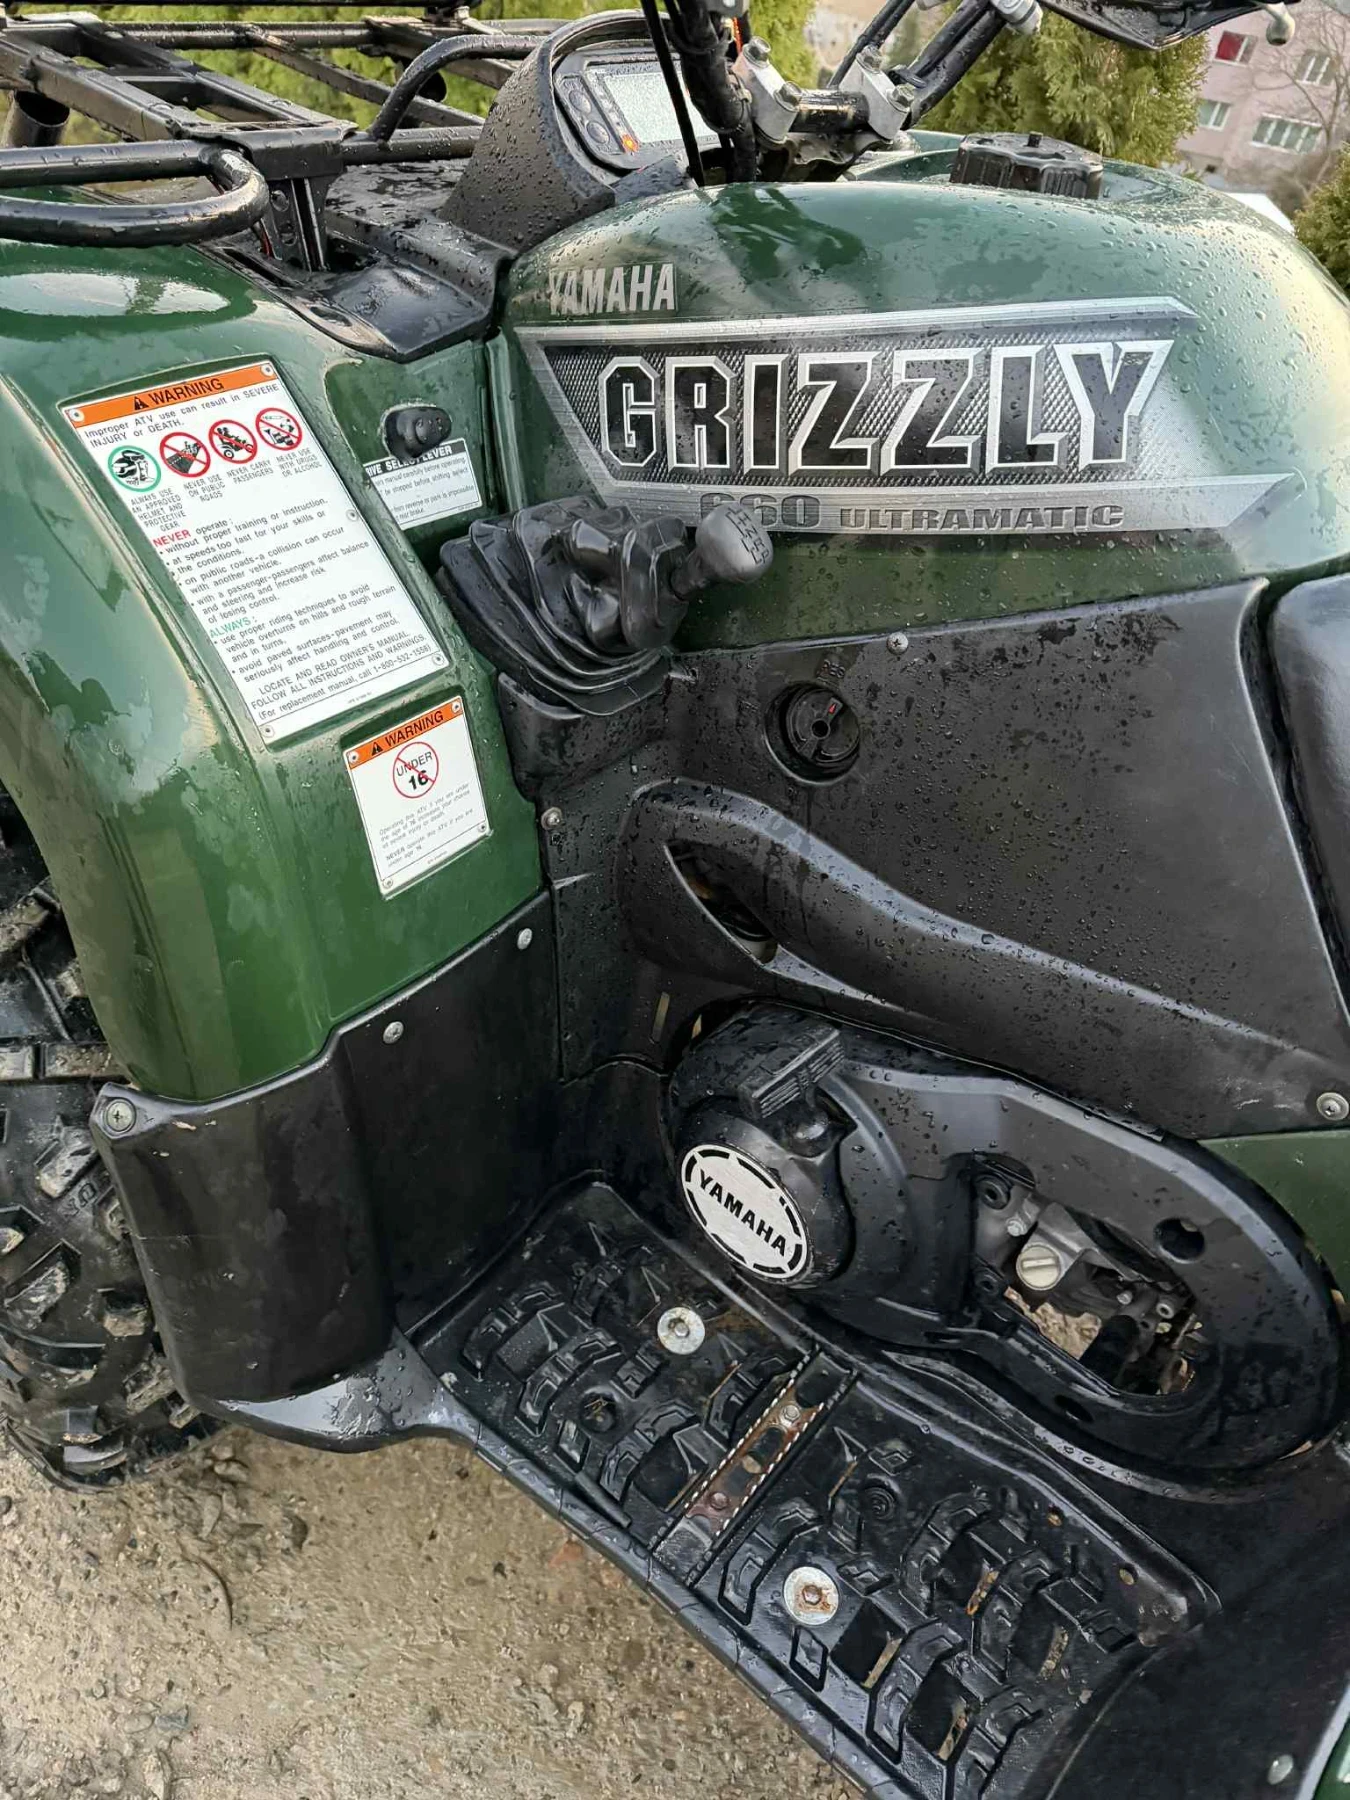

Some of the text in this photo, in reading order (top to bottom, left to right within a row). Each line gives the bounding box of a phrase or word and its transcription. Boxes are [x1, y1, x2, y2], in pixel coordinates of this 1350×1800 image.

[549, 263, 675, 316] YAMAHA
[148, 377, 225, 405] WARNING
[83, 383, 280, 439] Improper ATV use can result in SEVERE
[600, 339, 1174, 475] GRIZZLY
[89, 432, 128, 447] INJURY
[147, 418, 184, 433] DEATH.
[182, 473, 222, 490] NEVER USE
[225, 459, 272, 477] NEVER CARRY
[231, 466, 275, 484] PASSENGERS
[129, 487, 173, 505] ALWAYS USE
[143, 493, 182, 510] APPROVED
[187, 481, 226, 497] ON PUBLIC
[198, 490, 223, 502] ROADS
[137, 502, 183, 521] HELMET AND
[143, 510, 187, 527] PROTECTIVE
[158, 520, 180, 531] GEAR
[163, 537, 199, 553] without
[202, 528, 233, 543] proper
[234, 515, 269, 533] training
[282, 497, 328, 516] instruction.
[840, 504, 1124, 532] ULTRAMATIC
[152, 529, 191, 547] NEVER
[170, 555, 182, 564] at
[182, 544, 217, 562] speeds
[216, 539, 232, 550] too
[233, 533, 252, 544] fast
[253, 528, 268, 538] for
[270, 522, 291, 534] your
[291, 513, 314, 526] skills
[176, 546, 245, 574] the conditions.
[183, 576, 197, 584] on
[198, 565, 229, 581] public
[266, 540, 302, 557] collision
[304, 536, 320, 545] can
[322, 527, 345, 539] occur
[188, 558, 282, 594] with another vehicle.
[195, 593, 215, 605] with
[316, 551, 339, 563] affect
[340, 540, 370, 555] balance
[200, 566, 326, 614] and steering and increase risk
[206, 592, 280, 623] of losing control.
[219, 583, 370, 643] use proper riding techniques to avoid
[224, 585, 396, 653] vehicle overturns on hills and rough terrain
[230, 651, 248, 662] and
[249, 646, 260, 655] in
[236, 658, 263, 673] avoid
[265, 647, 294, 664] paved
[375, 610, 394, 622] may
[242, 662, 284, 684] seriously
[285, 651, 311, 666] affect
[313, 636, 350, 657] handling
[350, 629, 368, 640] and
[250, 633, 427, 709] FOLLOW ALL INSTRUCTIONS AND WARNINGS.
[257, 675, 292, 694] LOCATE
[293, 667, 313, 680] AND
[314, 657, 338, 672] READ
[338, 643, 375, 662] OWNER'S
[257, 707, 277, 721] (For
[277, 687, 327, 713] replacement
[326, 674, 359, 693] manual,
[357, 668, 372, 679] call
[384, 709, 443, 747] WARNING
[395, 750, 432, 777] UNDER
[407, 768, 429, 791] 16
[700, 1168, 787, 1257] YAMAHA
